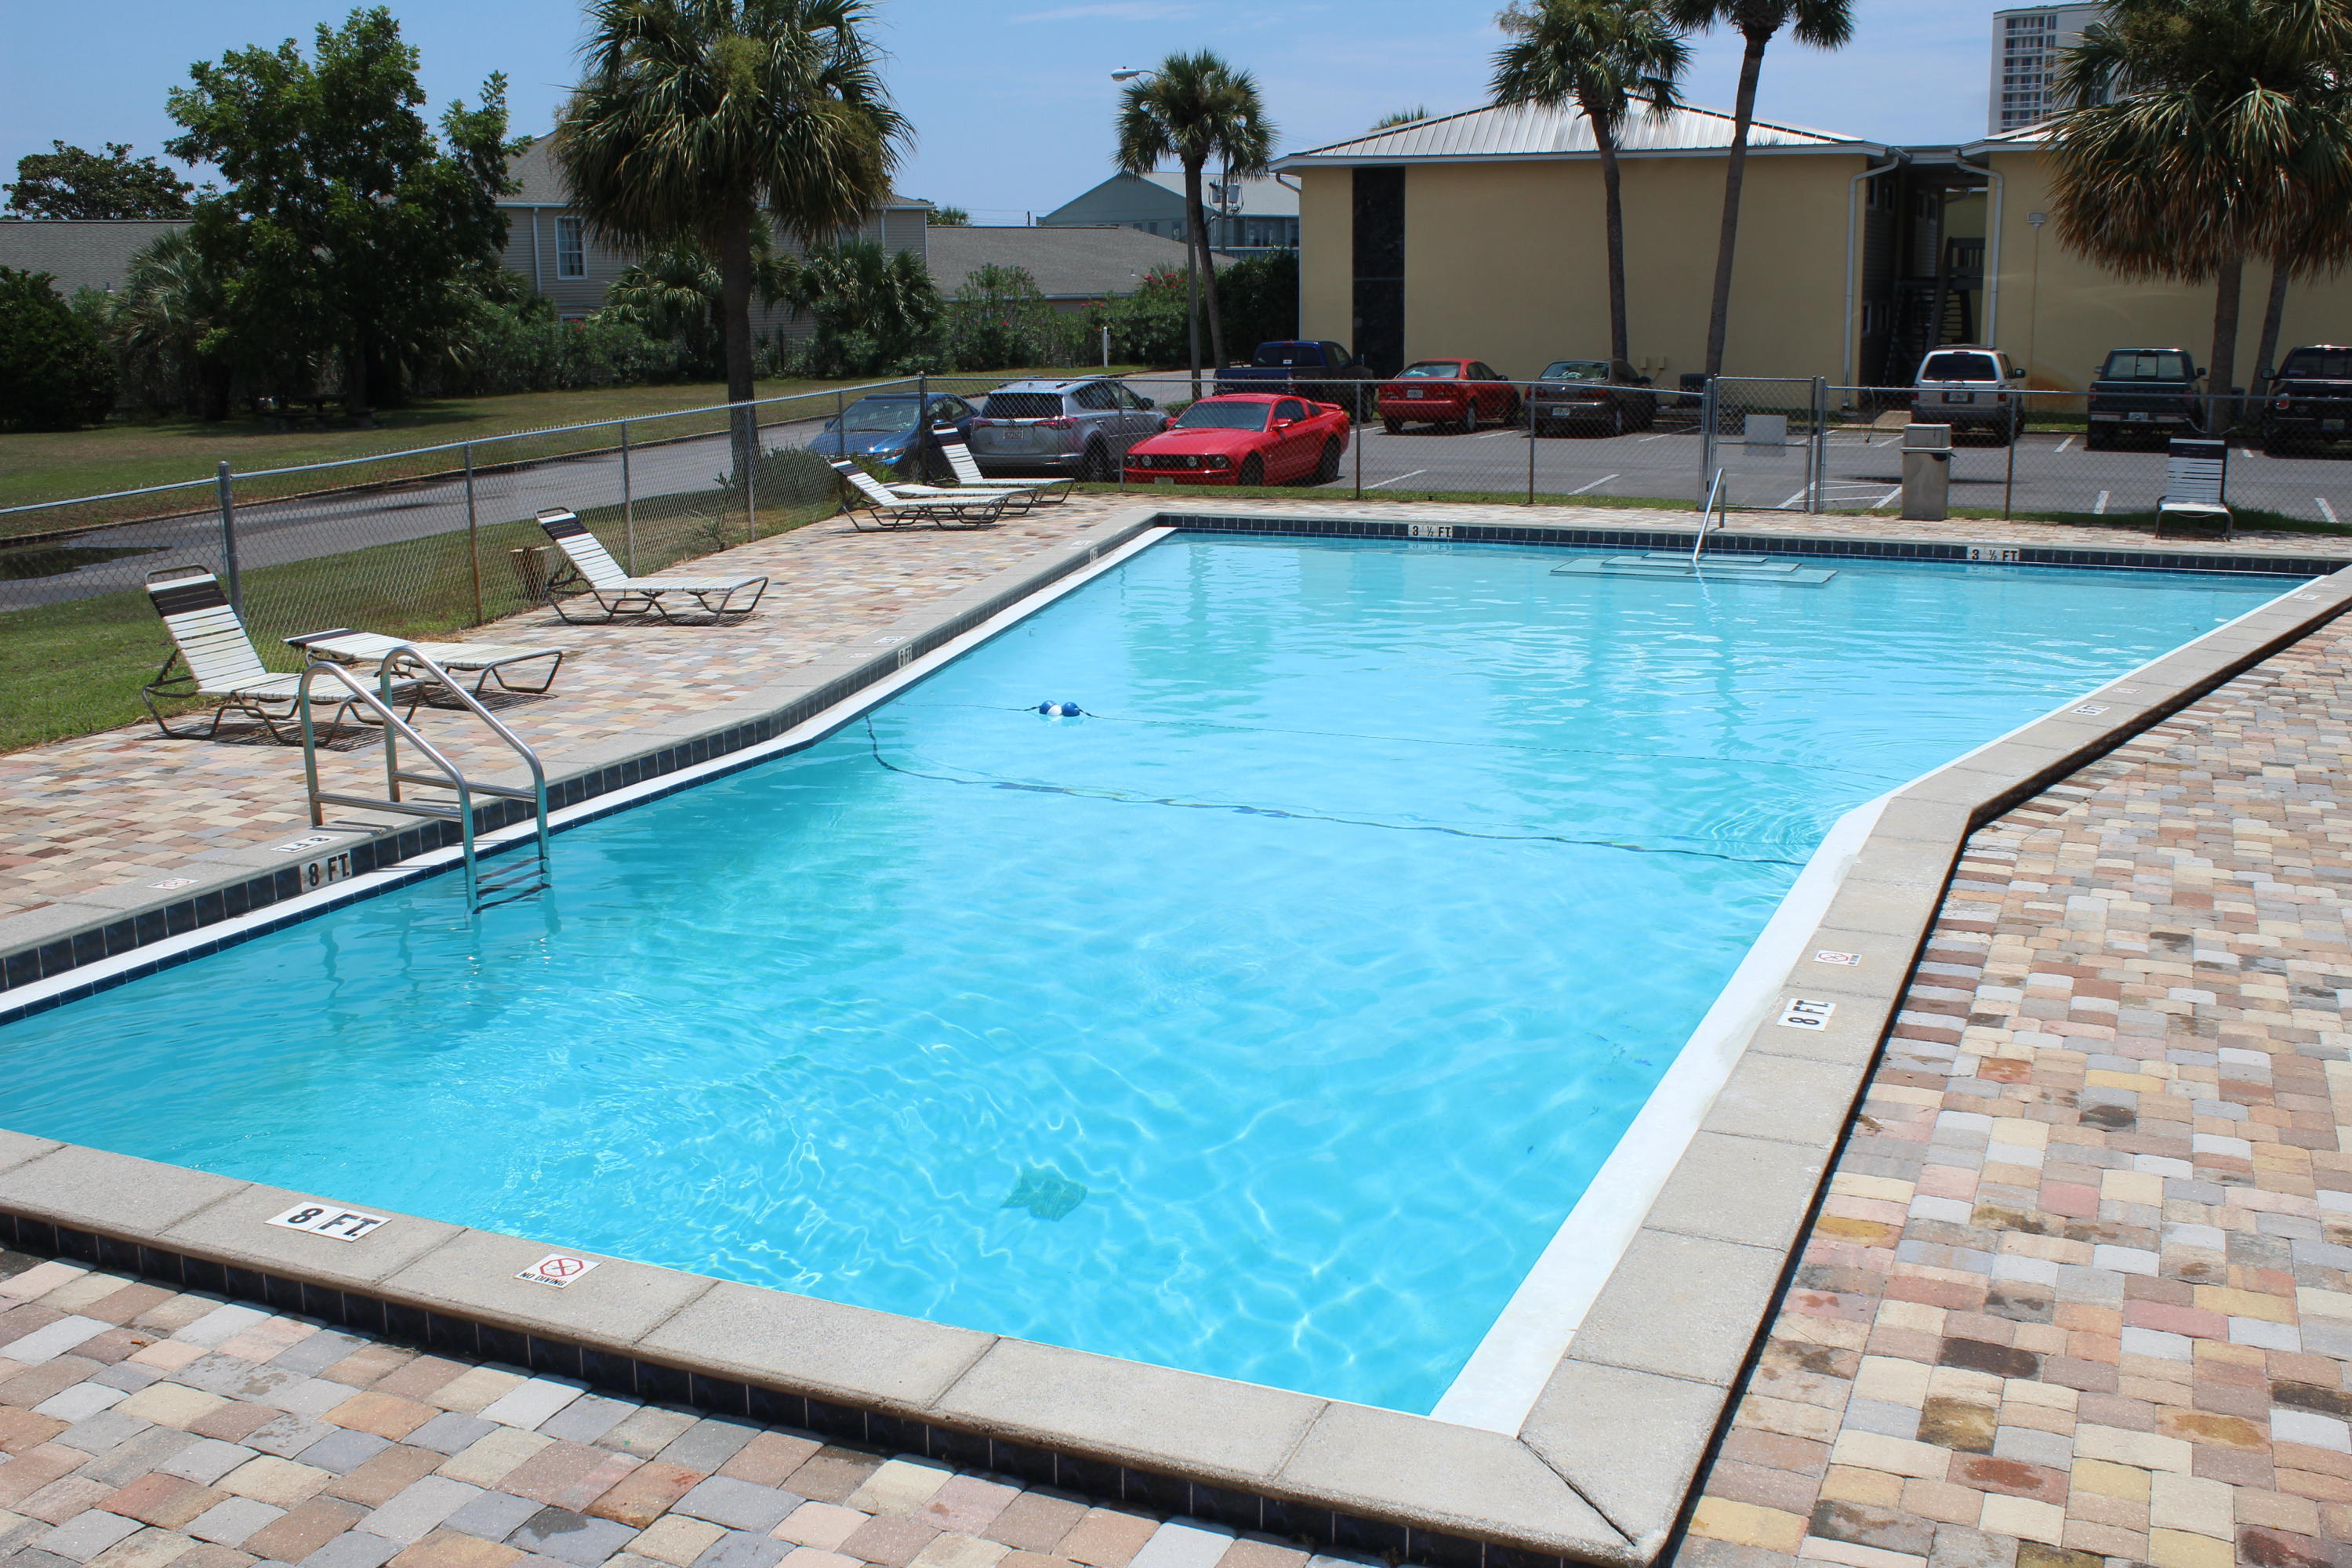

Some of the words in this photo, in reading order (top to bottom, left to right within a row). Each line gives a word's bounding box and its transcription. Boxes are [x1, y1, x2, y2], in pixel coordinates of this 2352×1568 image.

[1412, 525, 1419, 536] 3
[1972, 549, 1980, 560] 3
[309, 862, 320, 887] 8
[1788, 1016, 1820, 1025] 8
[287, 1207, 325, 1224] 8
[318, 1213, 382, 1236] FT.
[534, 1275, 568, 1287] DIVING
